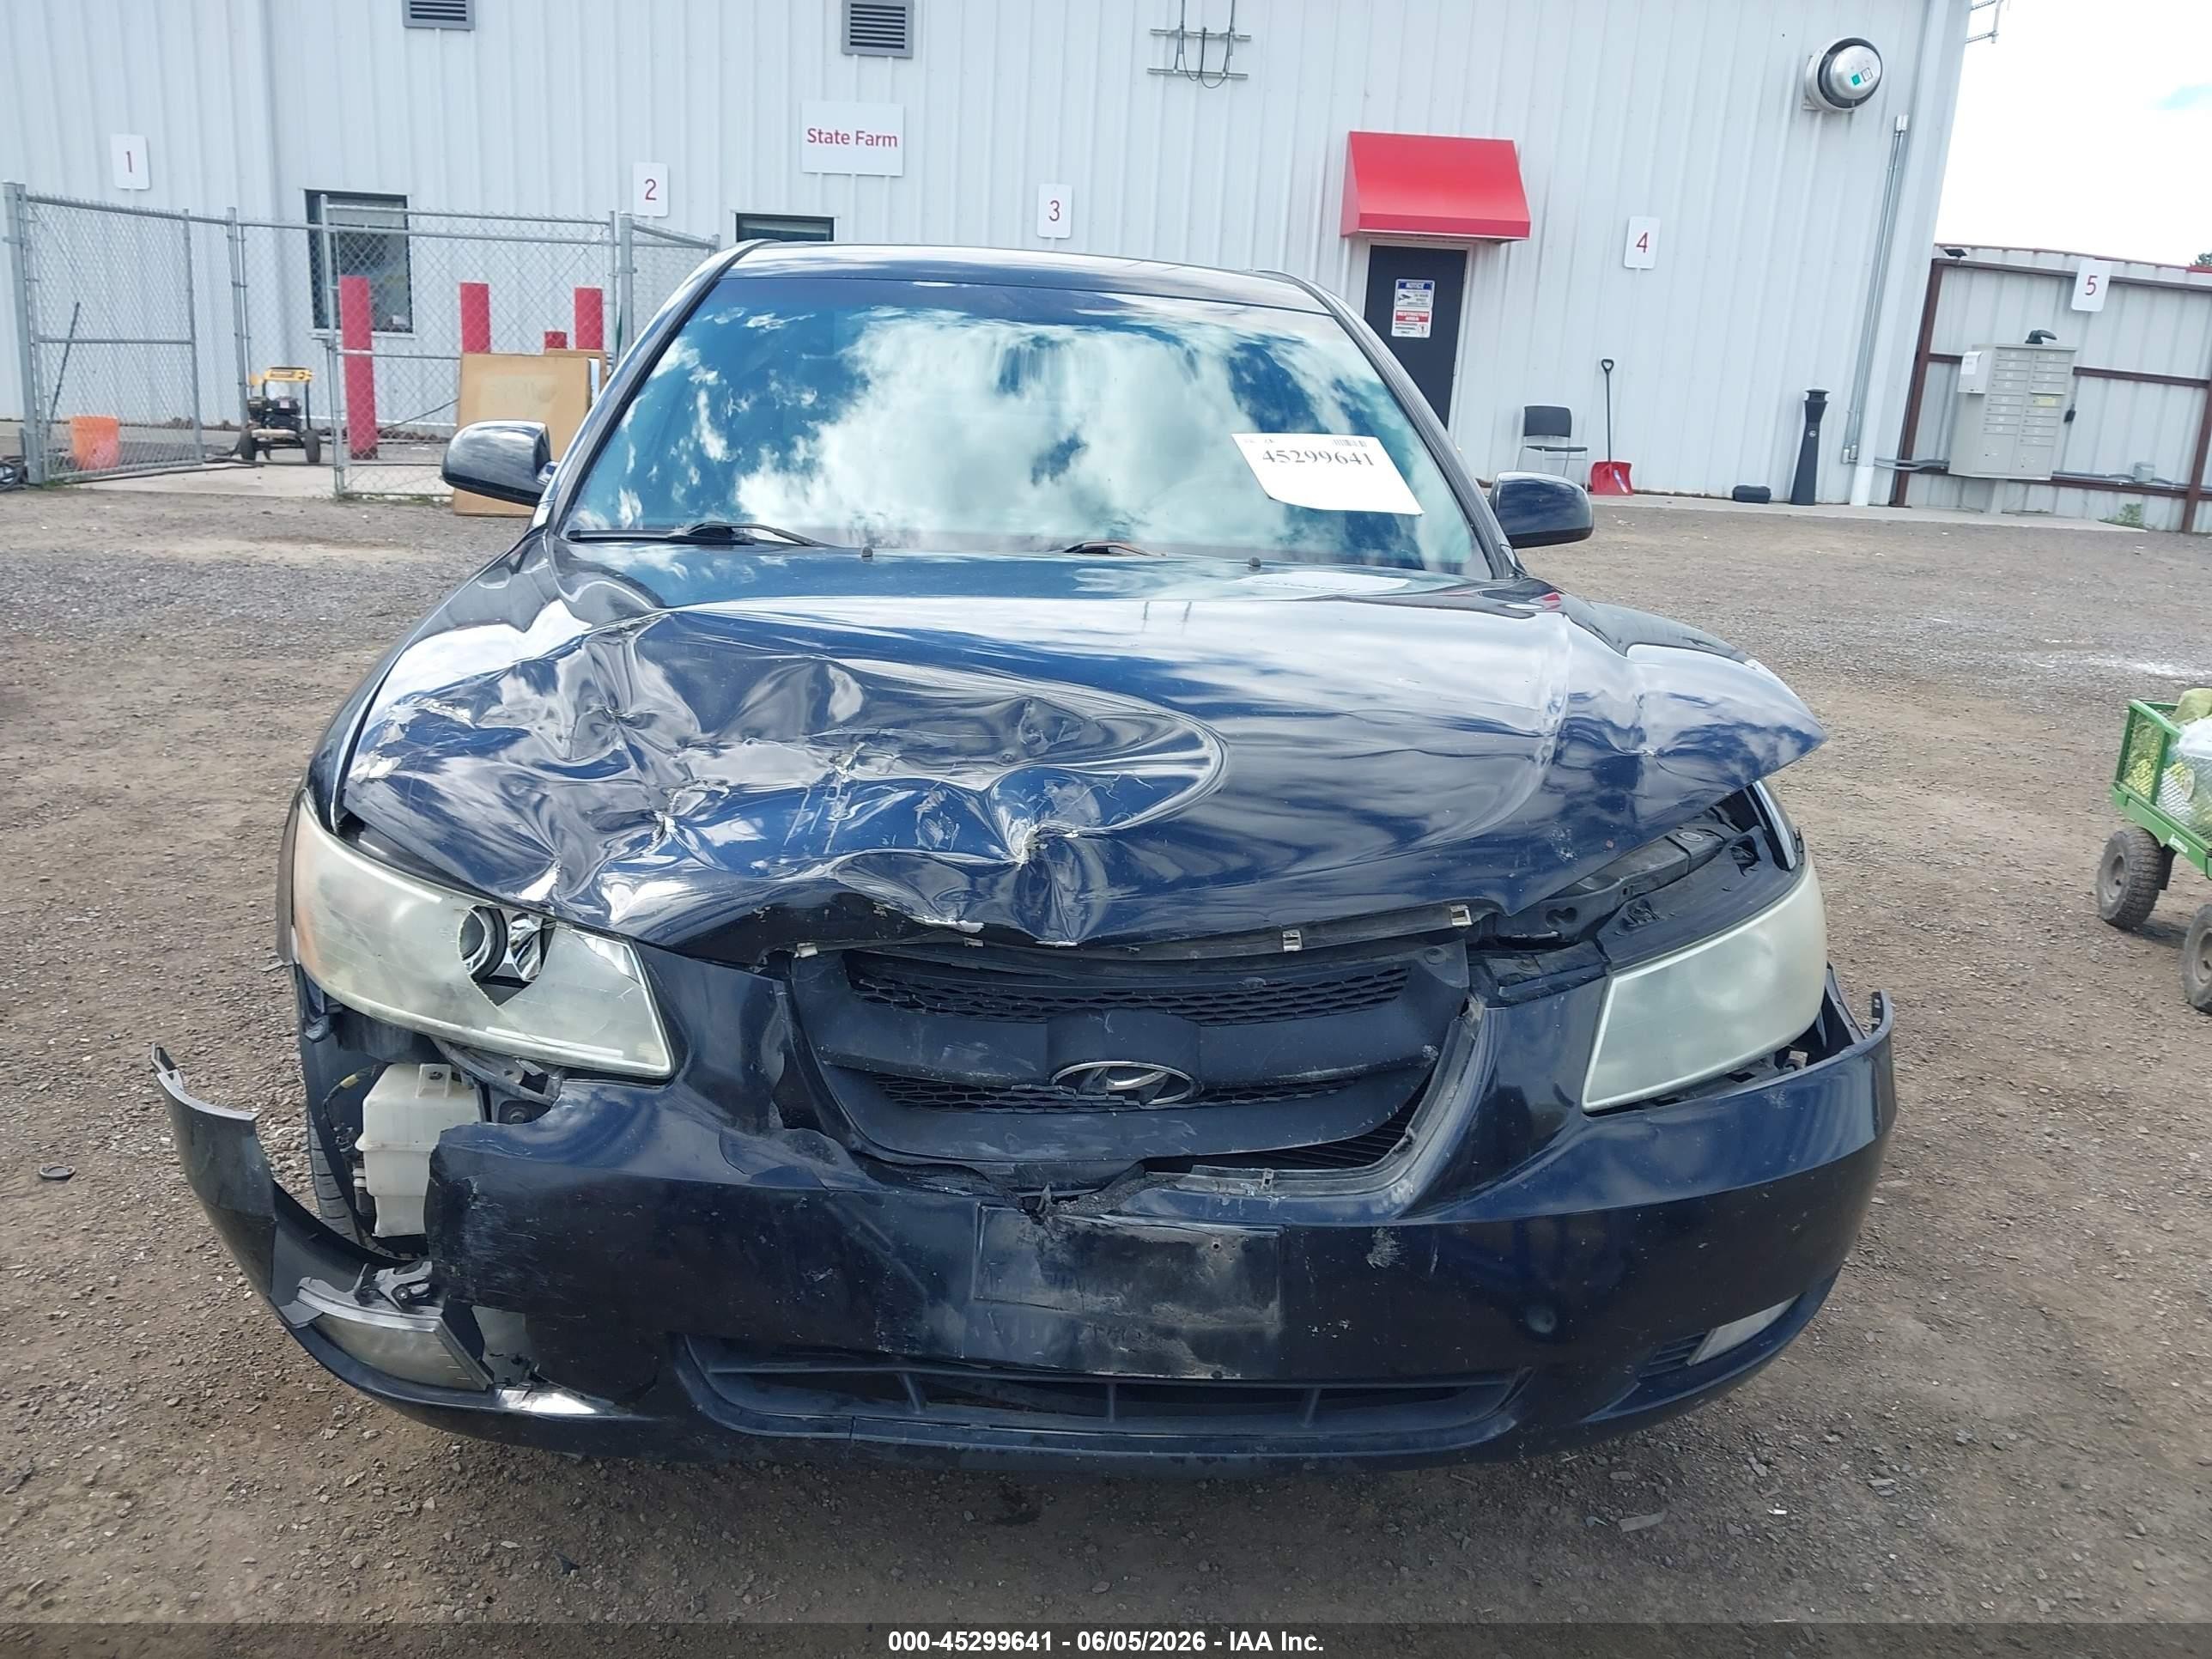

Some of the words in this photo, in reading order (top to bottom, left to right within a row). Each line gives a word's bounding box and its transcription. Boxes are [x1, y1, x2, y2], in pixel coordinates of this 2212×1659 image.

[807, 127, 850, 145] State
[855, 130, 898, 148] Farm
[125, 150, 133, 173] 1
[644, 178, 658, 201] 2
[1048, 199, 1060, 222] 3
[1635, 231, 1650, 254] 4
[2083, 274, 2099, 297] 5
[1261, 448, 1375, 467] 45299641
